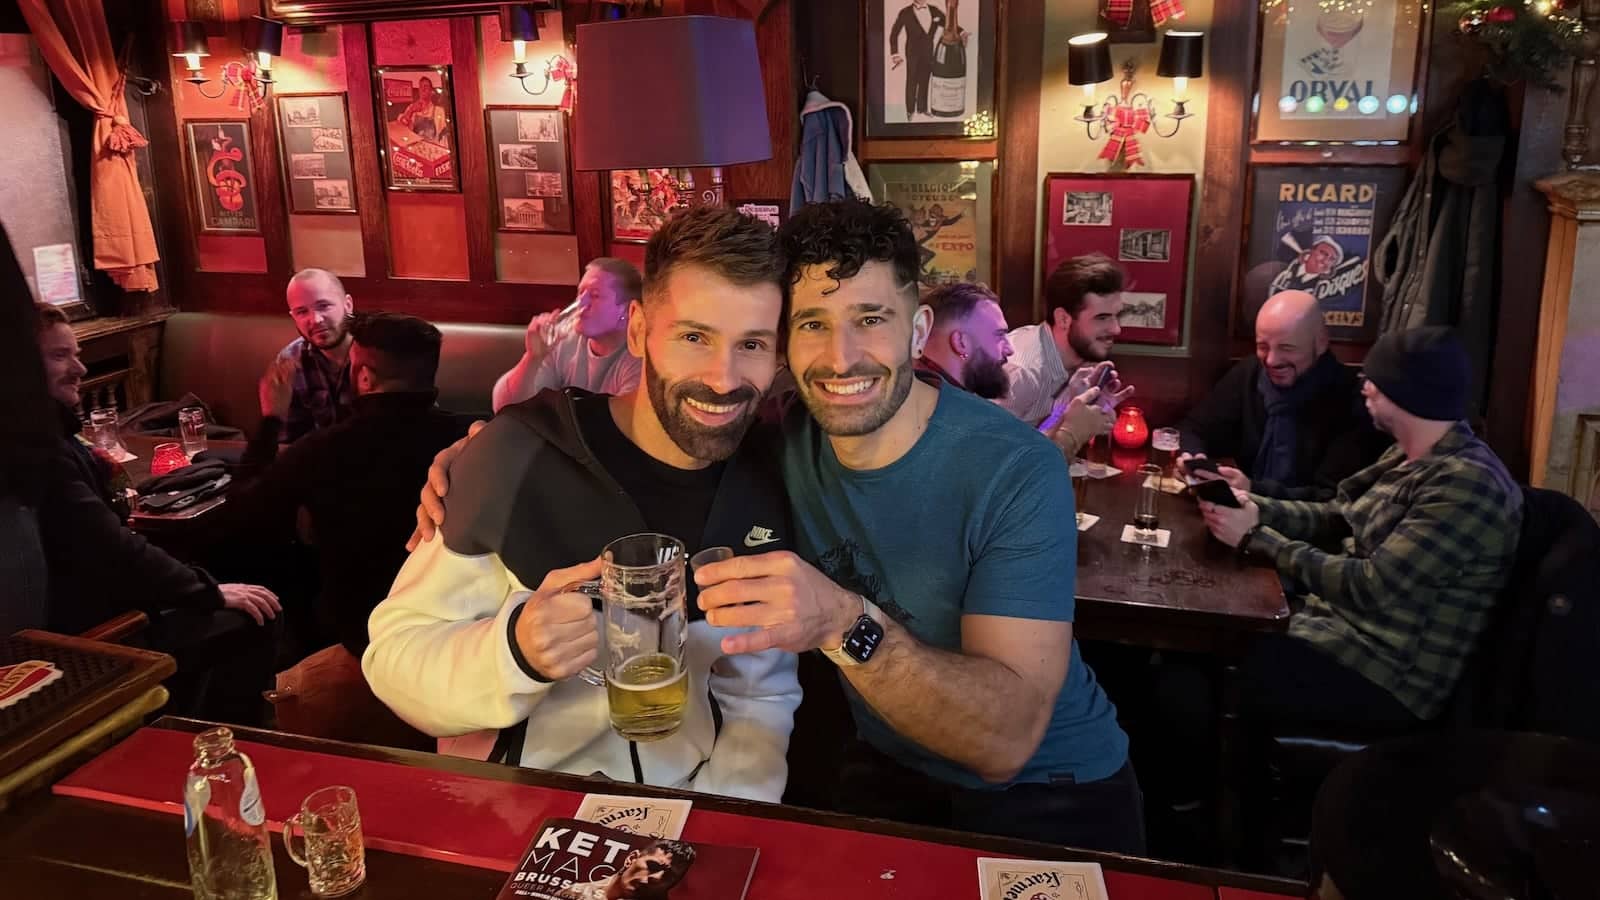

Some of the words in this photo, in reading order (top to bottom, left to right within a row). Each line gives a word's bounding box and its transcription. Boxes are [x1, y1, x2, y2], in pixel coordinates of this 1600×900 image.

[1280, 183, 1373, 203] RICARD
[211, 217, 257, 228] CAMPARI
[751, 525, 773, 540] NIKE
[599, 806, 648, 826] Karm
[535, 827, 631, 864] KET
[520, 850, 617, 883] MAG
[513, 871, 607, 900] BRUSSELS
[1003, 872, 1060, 900] Karme
